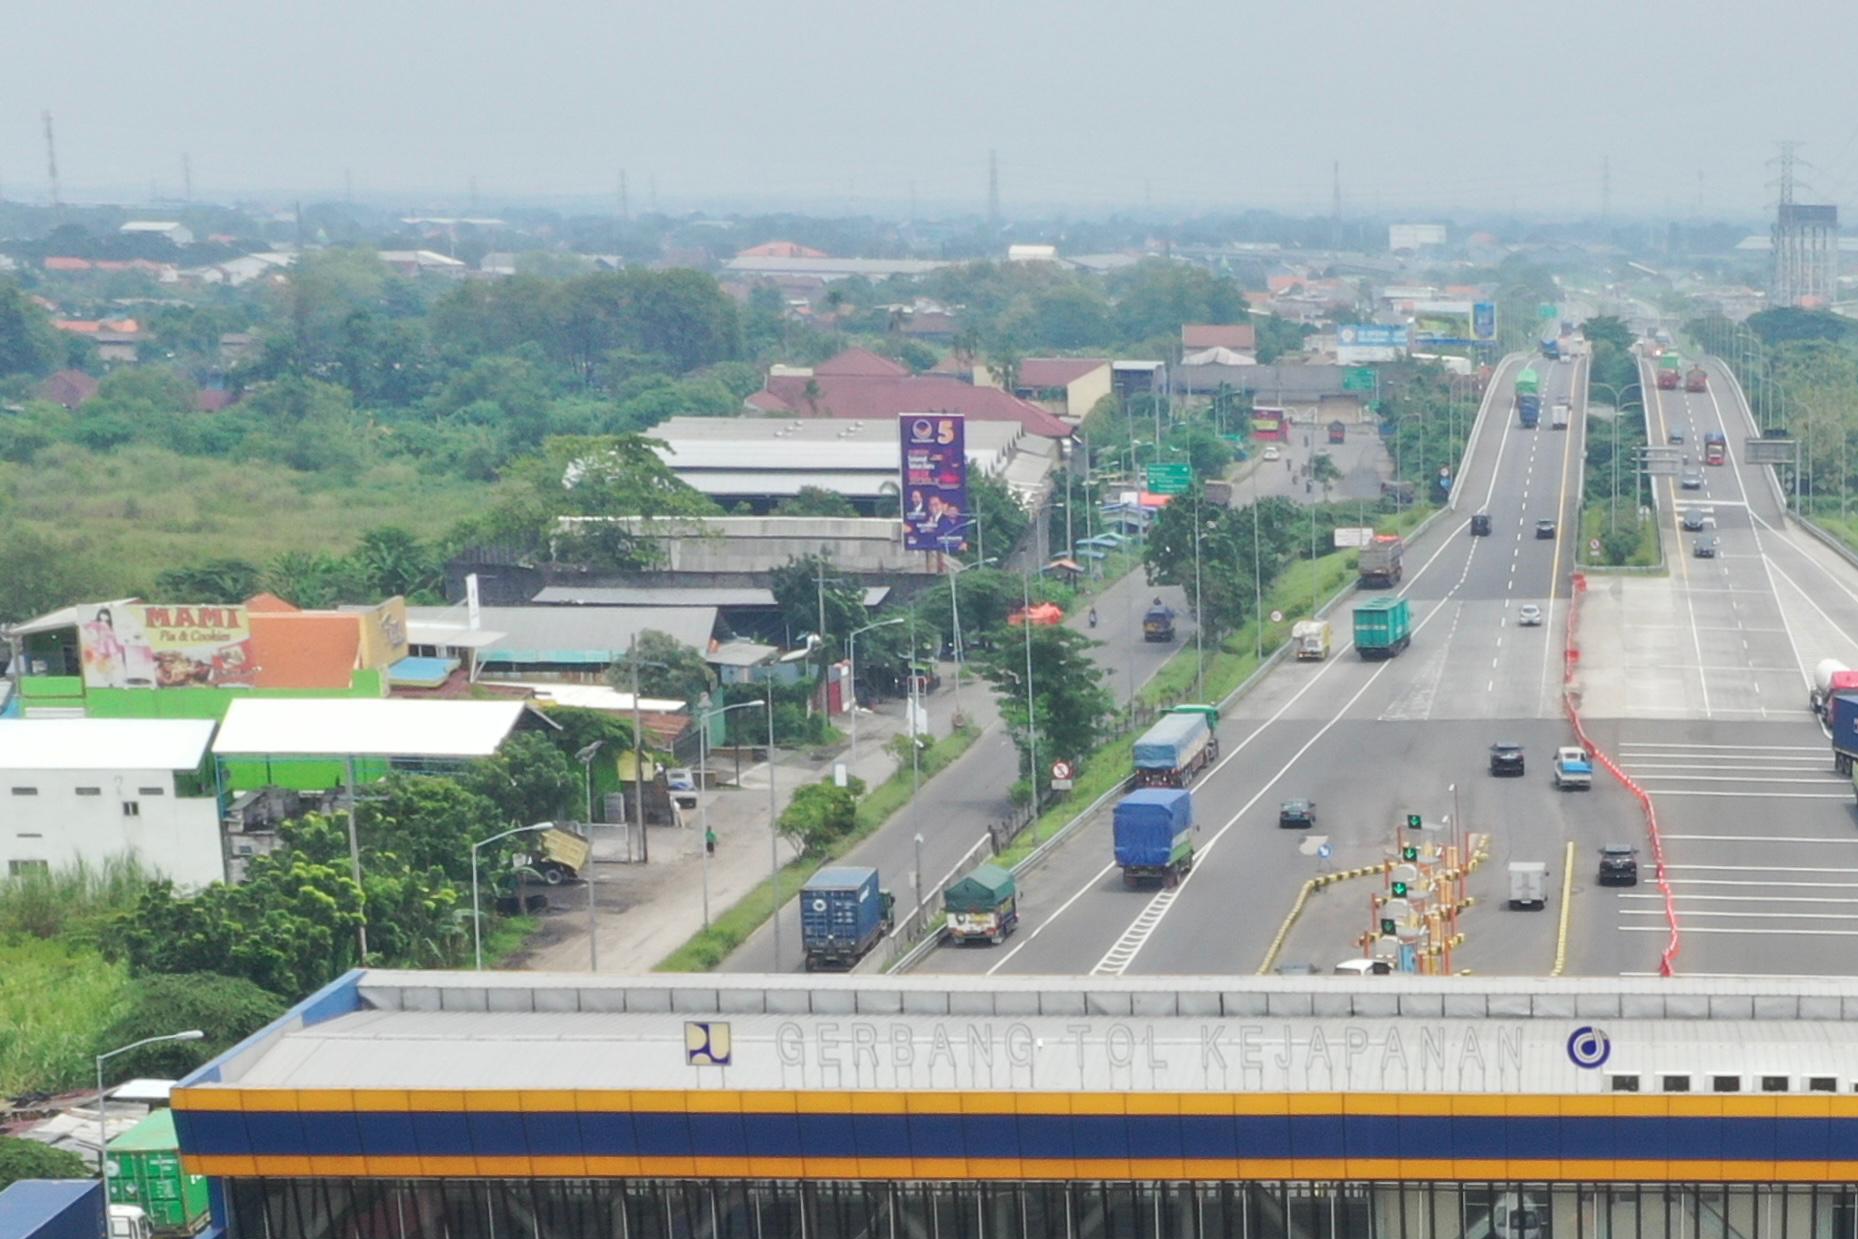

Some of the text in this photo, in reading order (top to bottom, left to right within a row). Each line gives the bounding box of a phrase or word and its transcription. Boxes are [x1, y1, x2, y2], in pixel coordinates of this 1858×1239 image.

[936, 420, 954, 445] 5
[145, 607, 241, 629] MAMI
[191, 630, 231, 642] Cookies
[775, 1022, 1522, 1070] GERBANG TOL KEJAPANAN
